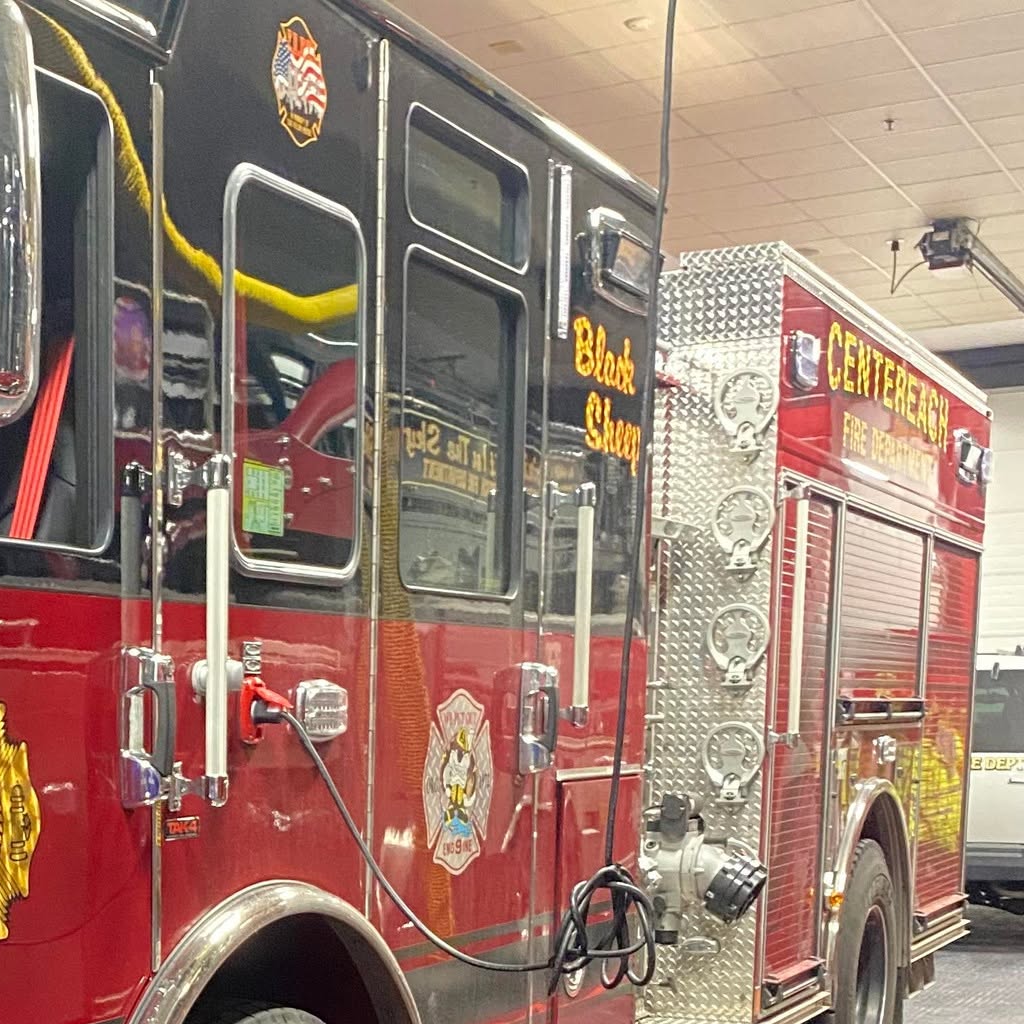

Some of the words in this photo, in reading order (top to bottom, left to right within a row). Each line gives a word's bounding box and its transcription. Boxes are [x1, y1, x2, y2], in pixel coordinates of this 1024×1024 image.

[574, 316, 636, 396] Black
[828, 321, 949, 453] CENTEREACH
[842, 411, 868, 456] FIRE
